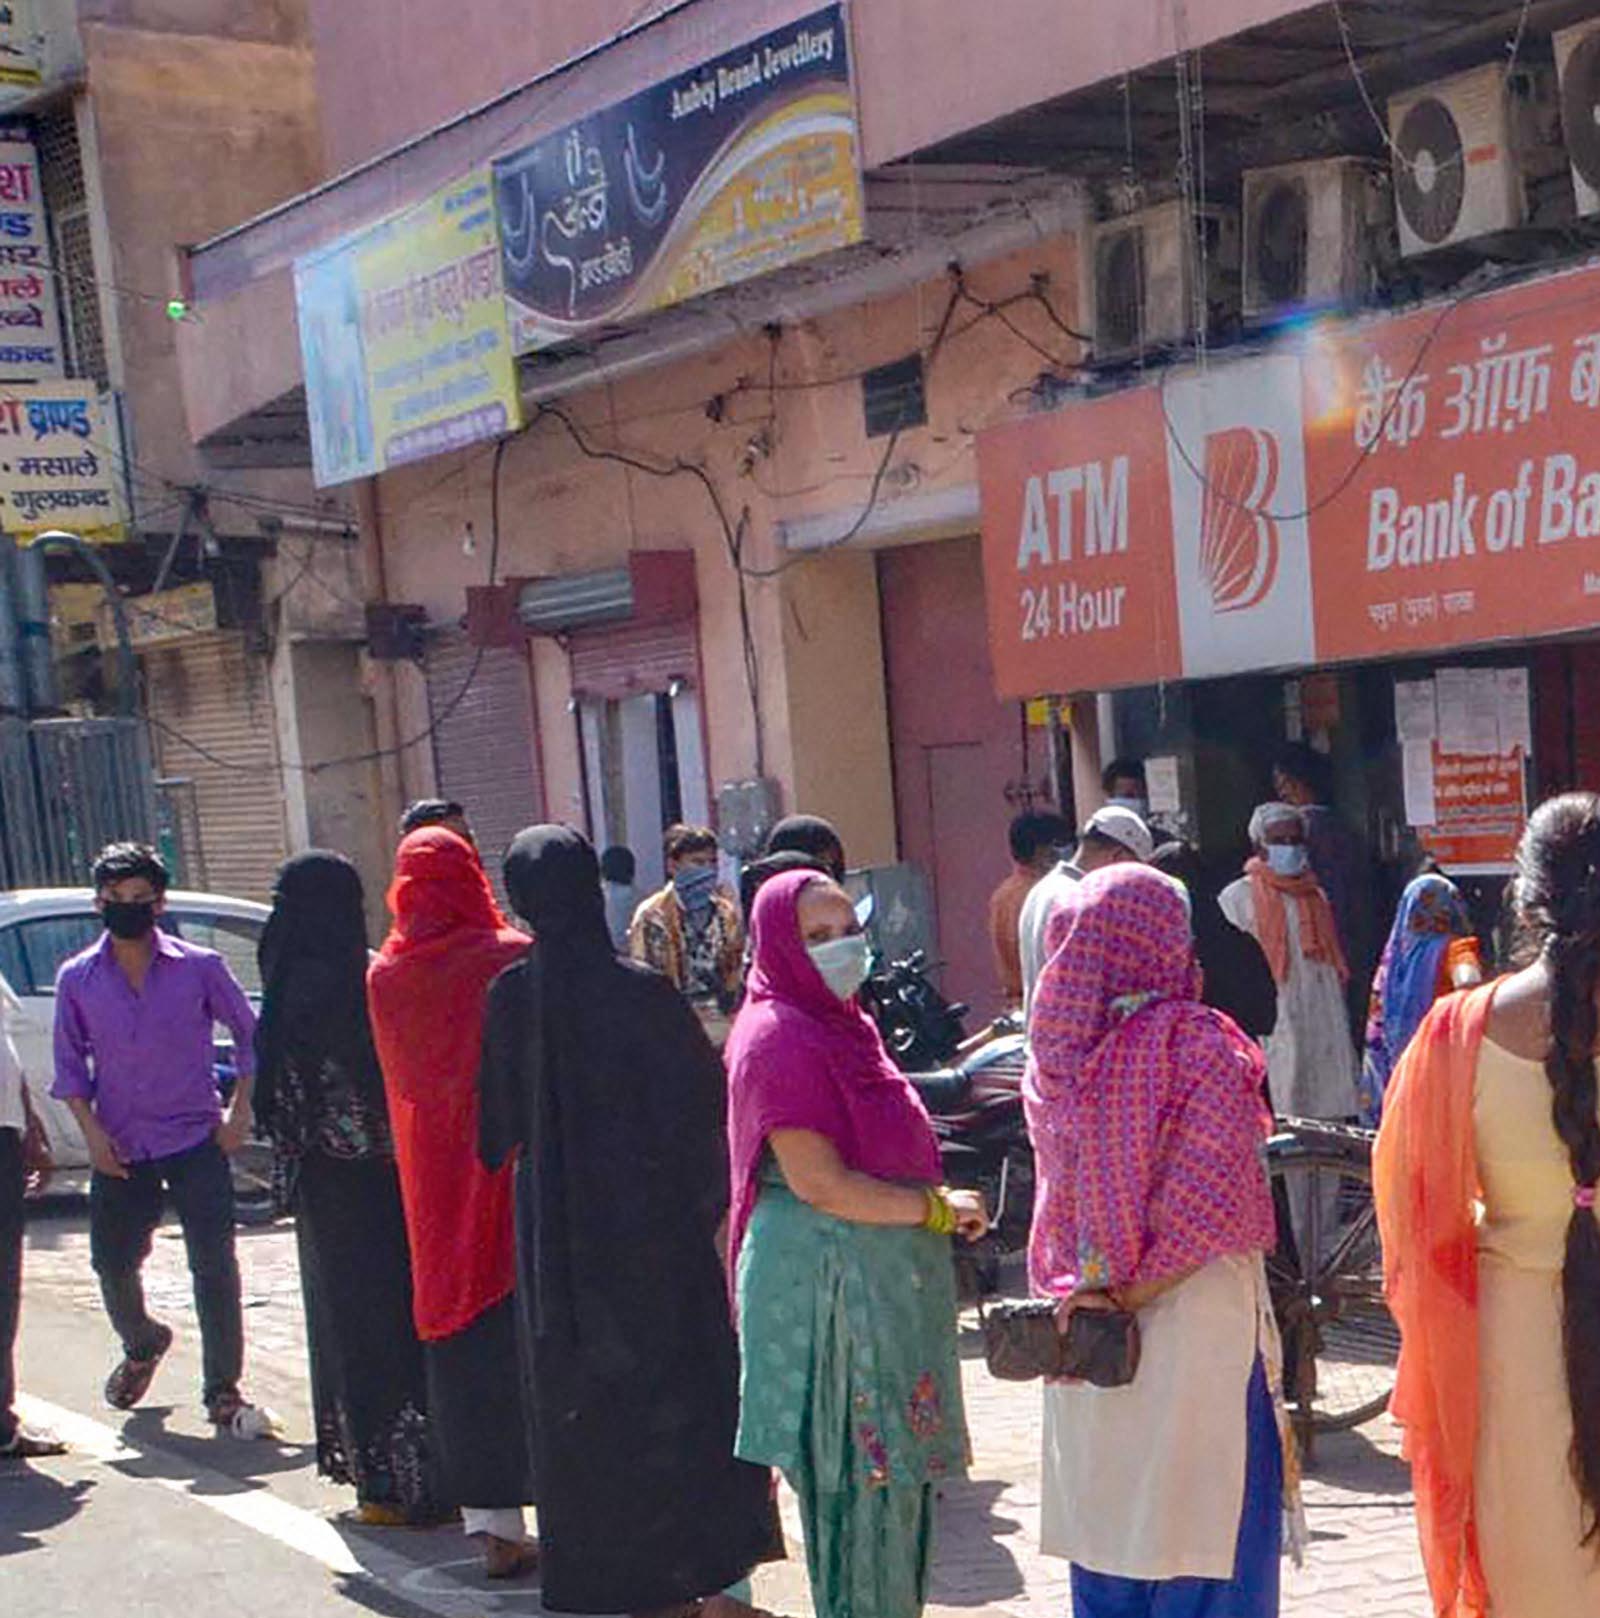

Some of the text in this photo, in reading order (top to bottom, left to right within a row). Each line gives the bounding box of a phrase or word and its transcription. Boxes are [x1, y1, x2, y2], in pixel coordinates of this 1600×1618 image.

[763, 28, 835, 80] Jewellery
[1354, 353, 1429, 453] बैंक
[18, 448, 98, 477] मसाले
[11, 489, 110, 521] गुलकन्द
[1016, 454, 1130, 572] ATM
[1366, 472, 1479, 572] Bank
[1485, 459, 1534, 553] of
[1020, 582, 1127, 642] 24 Hour
